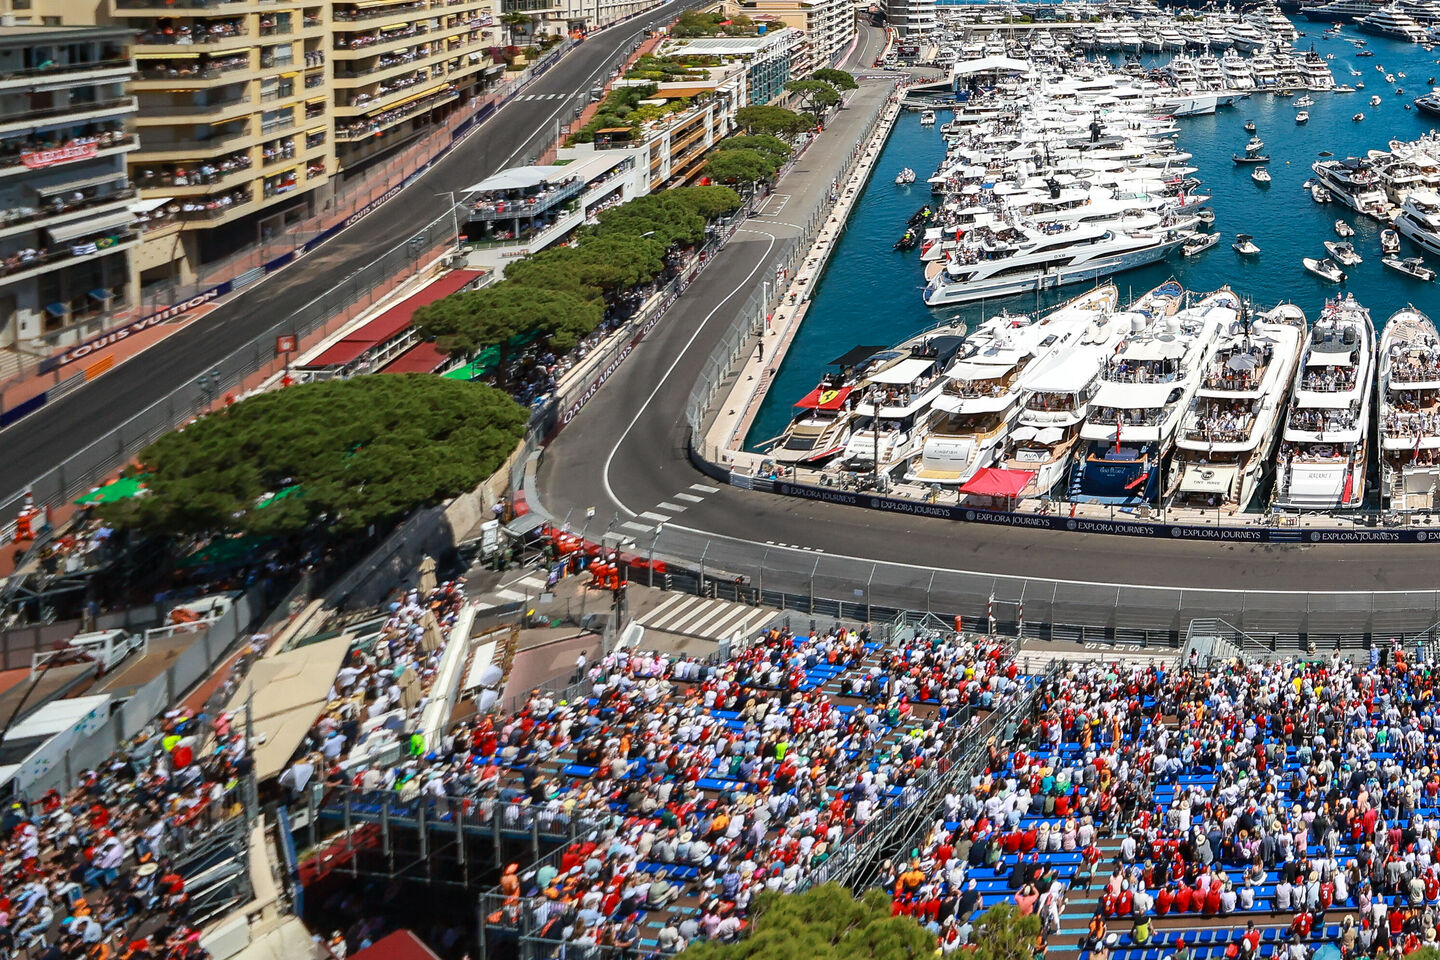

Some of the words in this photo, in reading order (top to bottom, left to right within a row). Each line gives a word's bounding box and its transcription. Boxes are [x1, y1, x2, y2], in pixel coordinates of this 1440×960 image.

[345, 206, 370, 226] LOUIS
[373, 185, 402, 208] VUITTON
[59, 327, 130, 365] LOUIS
[132, 290, 218, 330] VUITTON
[643, 306, 666, 335] QATAR
[563, 384, 596, 425] QATAR
[598, 346, 632, 385] AIRWAYS
[790, 487, 821, 498] EXPLORA
[822, 492, 856, 503] JOURNEYS
[880, 501, 913, 512] EXPLORA
[913, 506, 950, 517] JOURNEYS
[976, 513, 1011, 523] EXPLORA
[1012, 516, 1050, 527] JOURNEYS
[1078, 522, 1114, 532] EXPLORA
[1114, 525, 1154, 534] JOURNEYS
[1183, 529, 1220, 538] EXPLORA
[1220, 530, 1261, 539] JOURNEYS
[1358, 532, 1399, 541] JOURNEYS
[1323, 890, 1328, 899] 3
